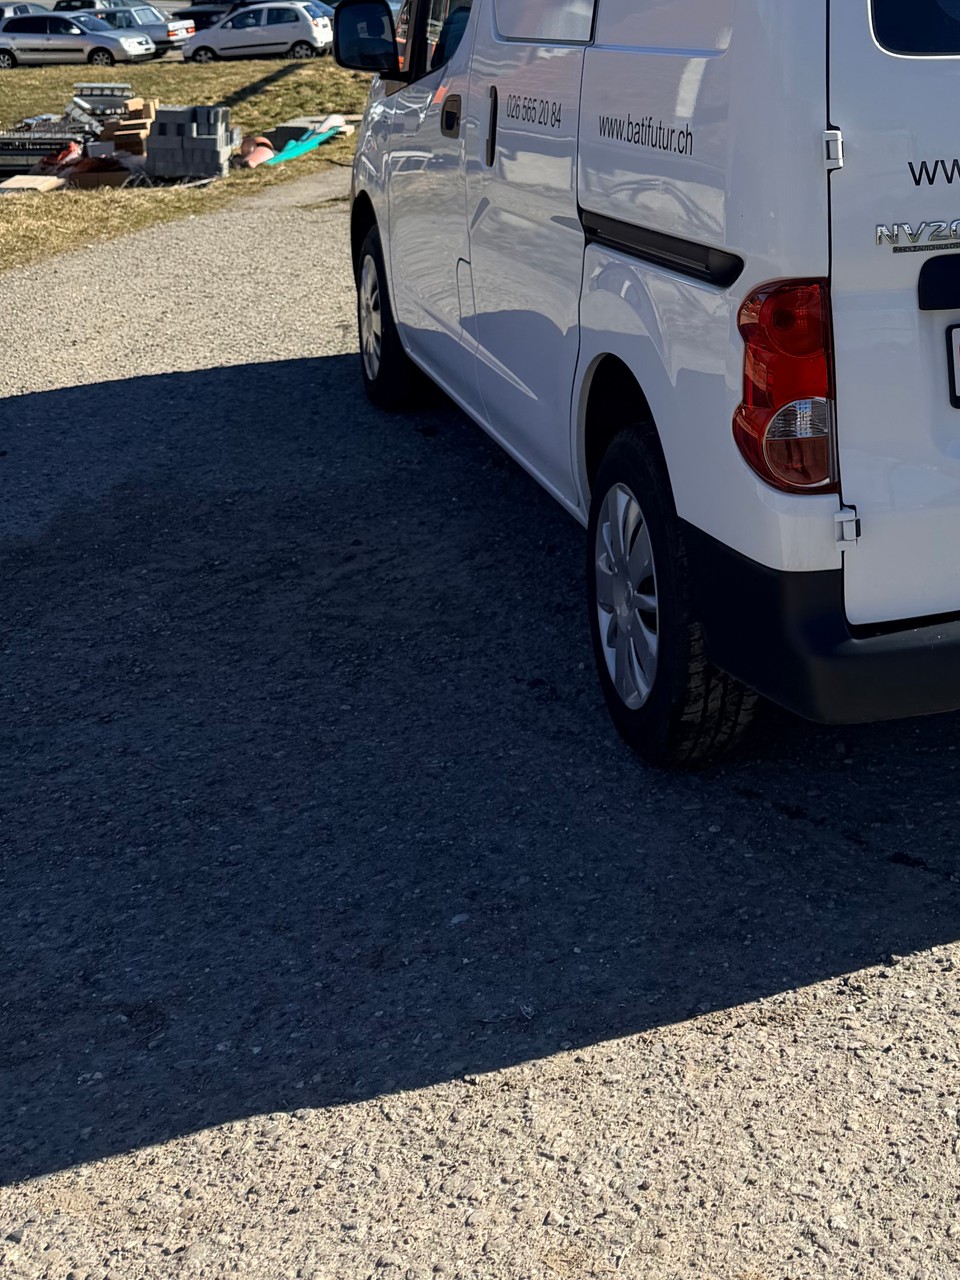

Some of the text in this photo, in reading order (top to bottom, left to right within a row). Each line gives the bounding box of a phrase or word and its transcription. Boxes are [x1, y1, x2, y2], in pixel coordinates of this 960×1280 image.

[507, 94, 562, 129] 026 565 20 84
[599, 113, 693, 156] www.batifutur.ch
